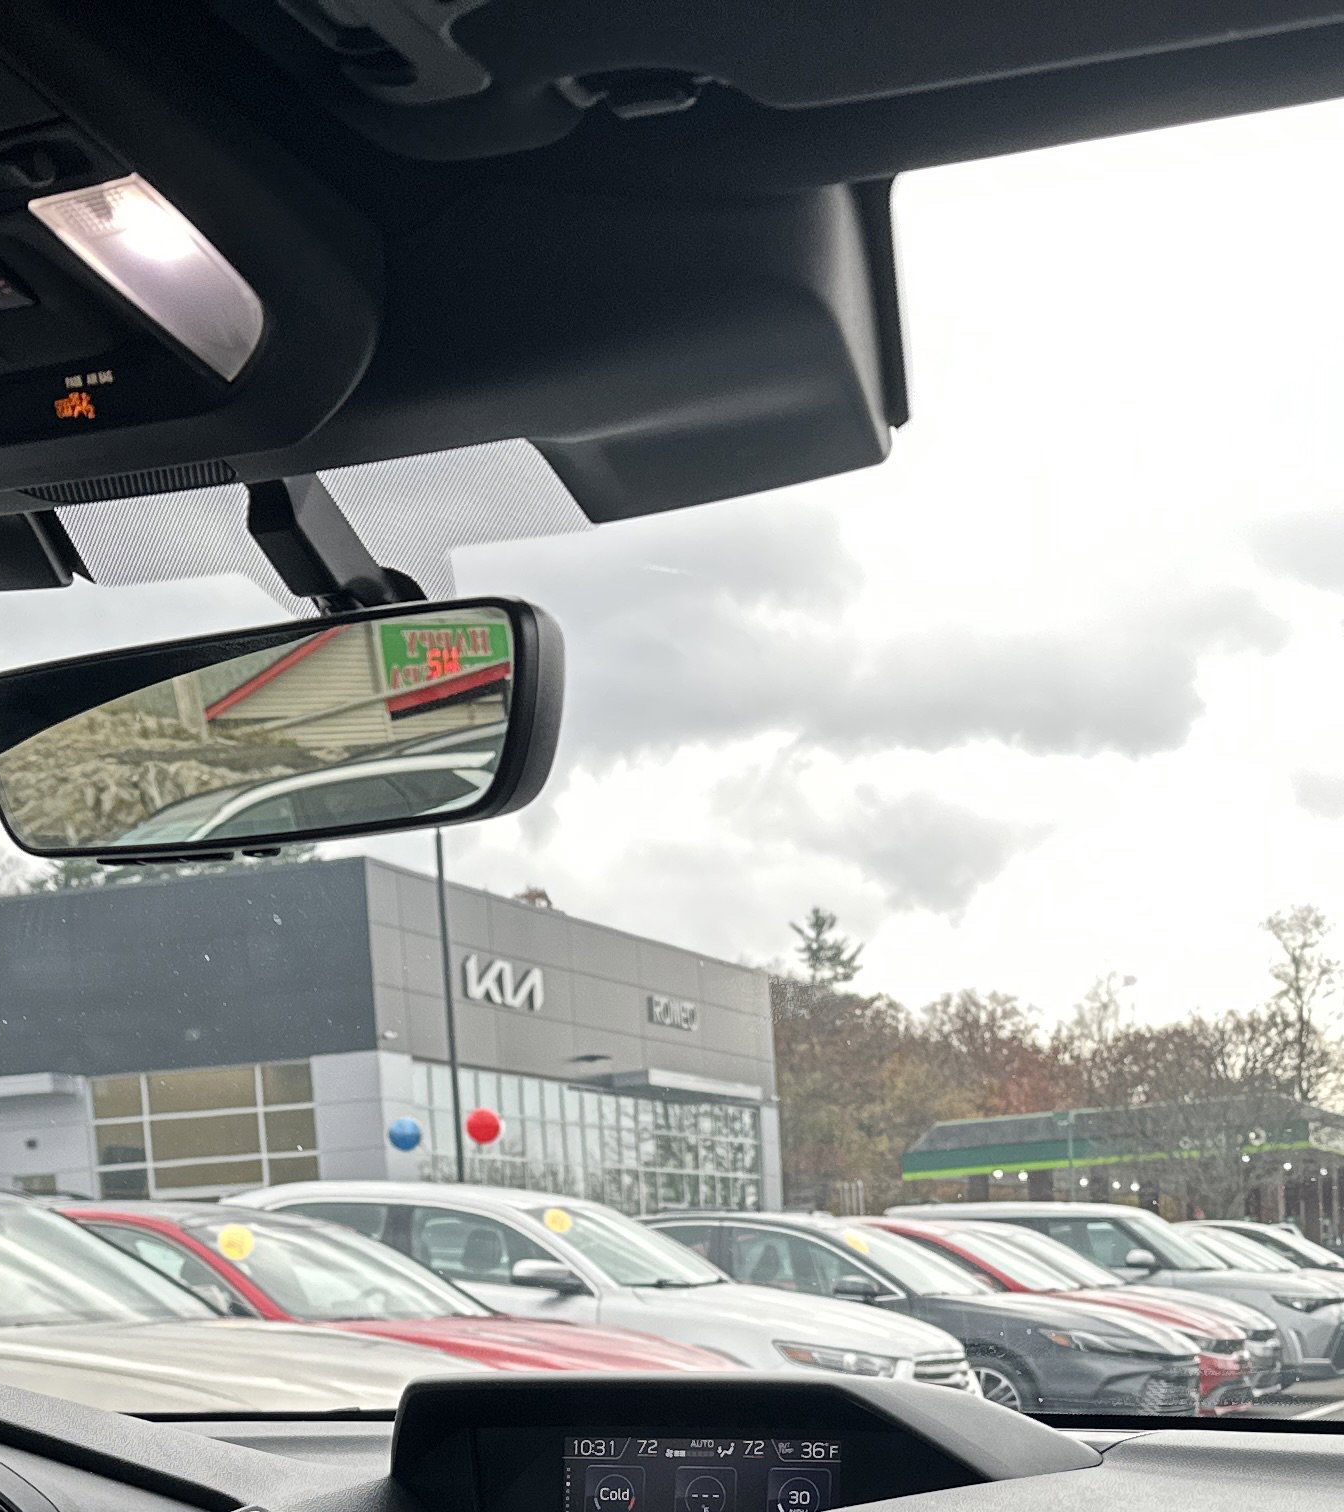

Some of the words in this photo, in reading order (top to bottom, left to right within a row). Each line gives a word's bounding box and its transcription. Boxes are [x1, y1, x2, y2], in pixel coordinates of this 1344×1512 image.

[464, 953, 544, 1012] KIA
[572, 1440, 616, 1456] 10:31
[637, 1440, 658, 1455] 72
[691, 1439, 714, 1448] AUTO
[743, 1440, 765, 1455] 72
[599, 1487, 630, 1501] Cold
[789, 1491, 810, 1505] 30
